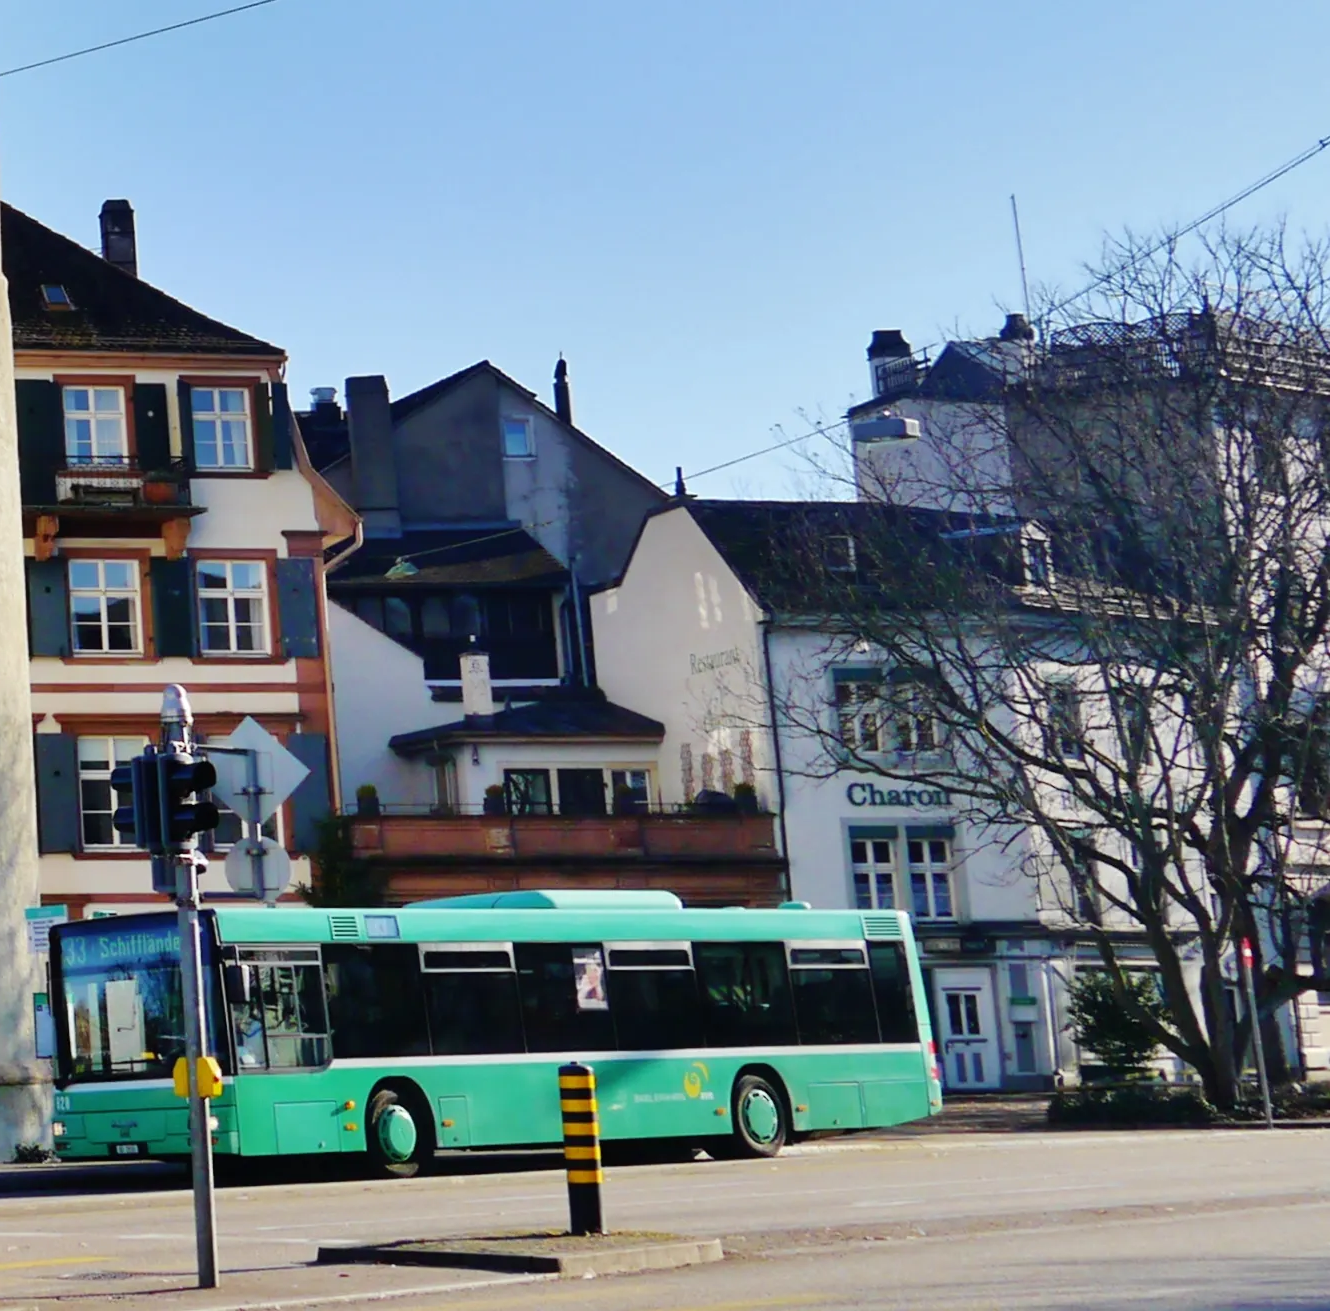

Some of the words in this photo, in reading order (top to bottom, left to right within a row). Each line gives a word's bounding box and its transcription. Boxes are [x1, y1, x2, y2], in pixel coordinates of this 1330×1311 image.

[846, 783, 953, 807] Charon
[64, 936, 86, 967] 33
[99, 931, 180, 959] Schifflände
